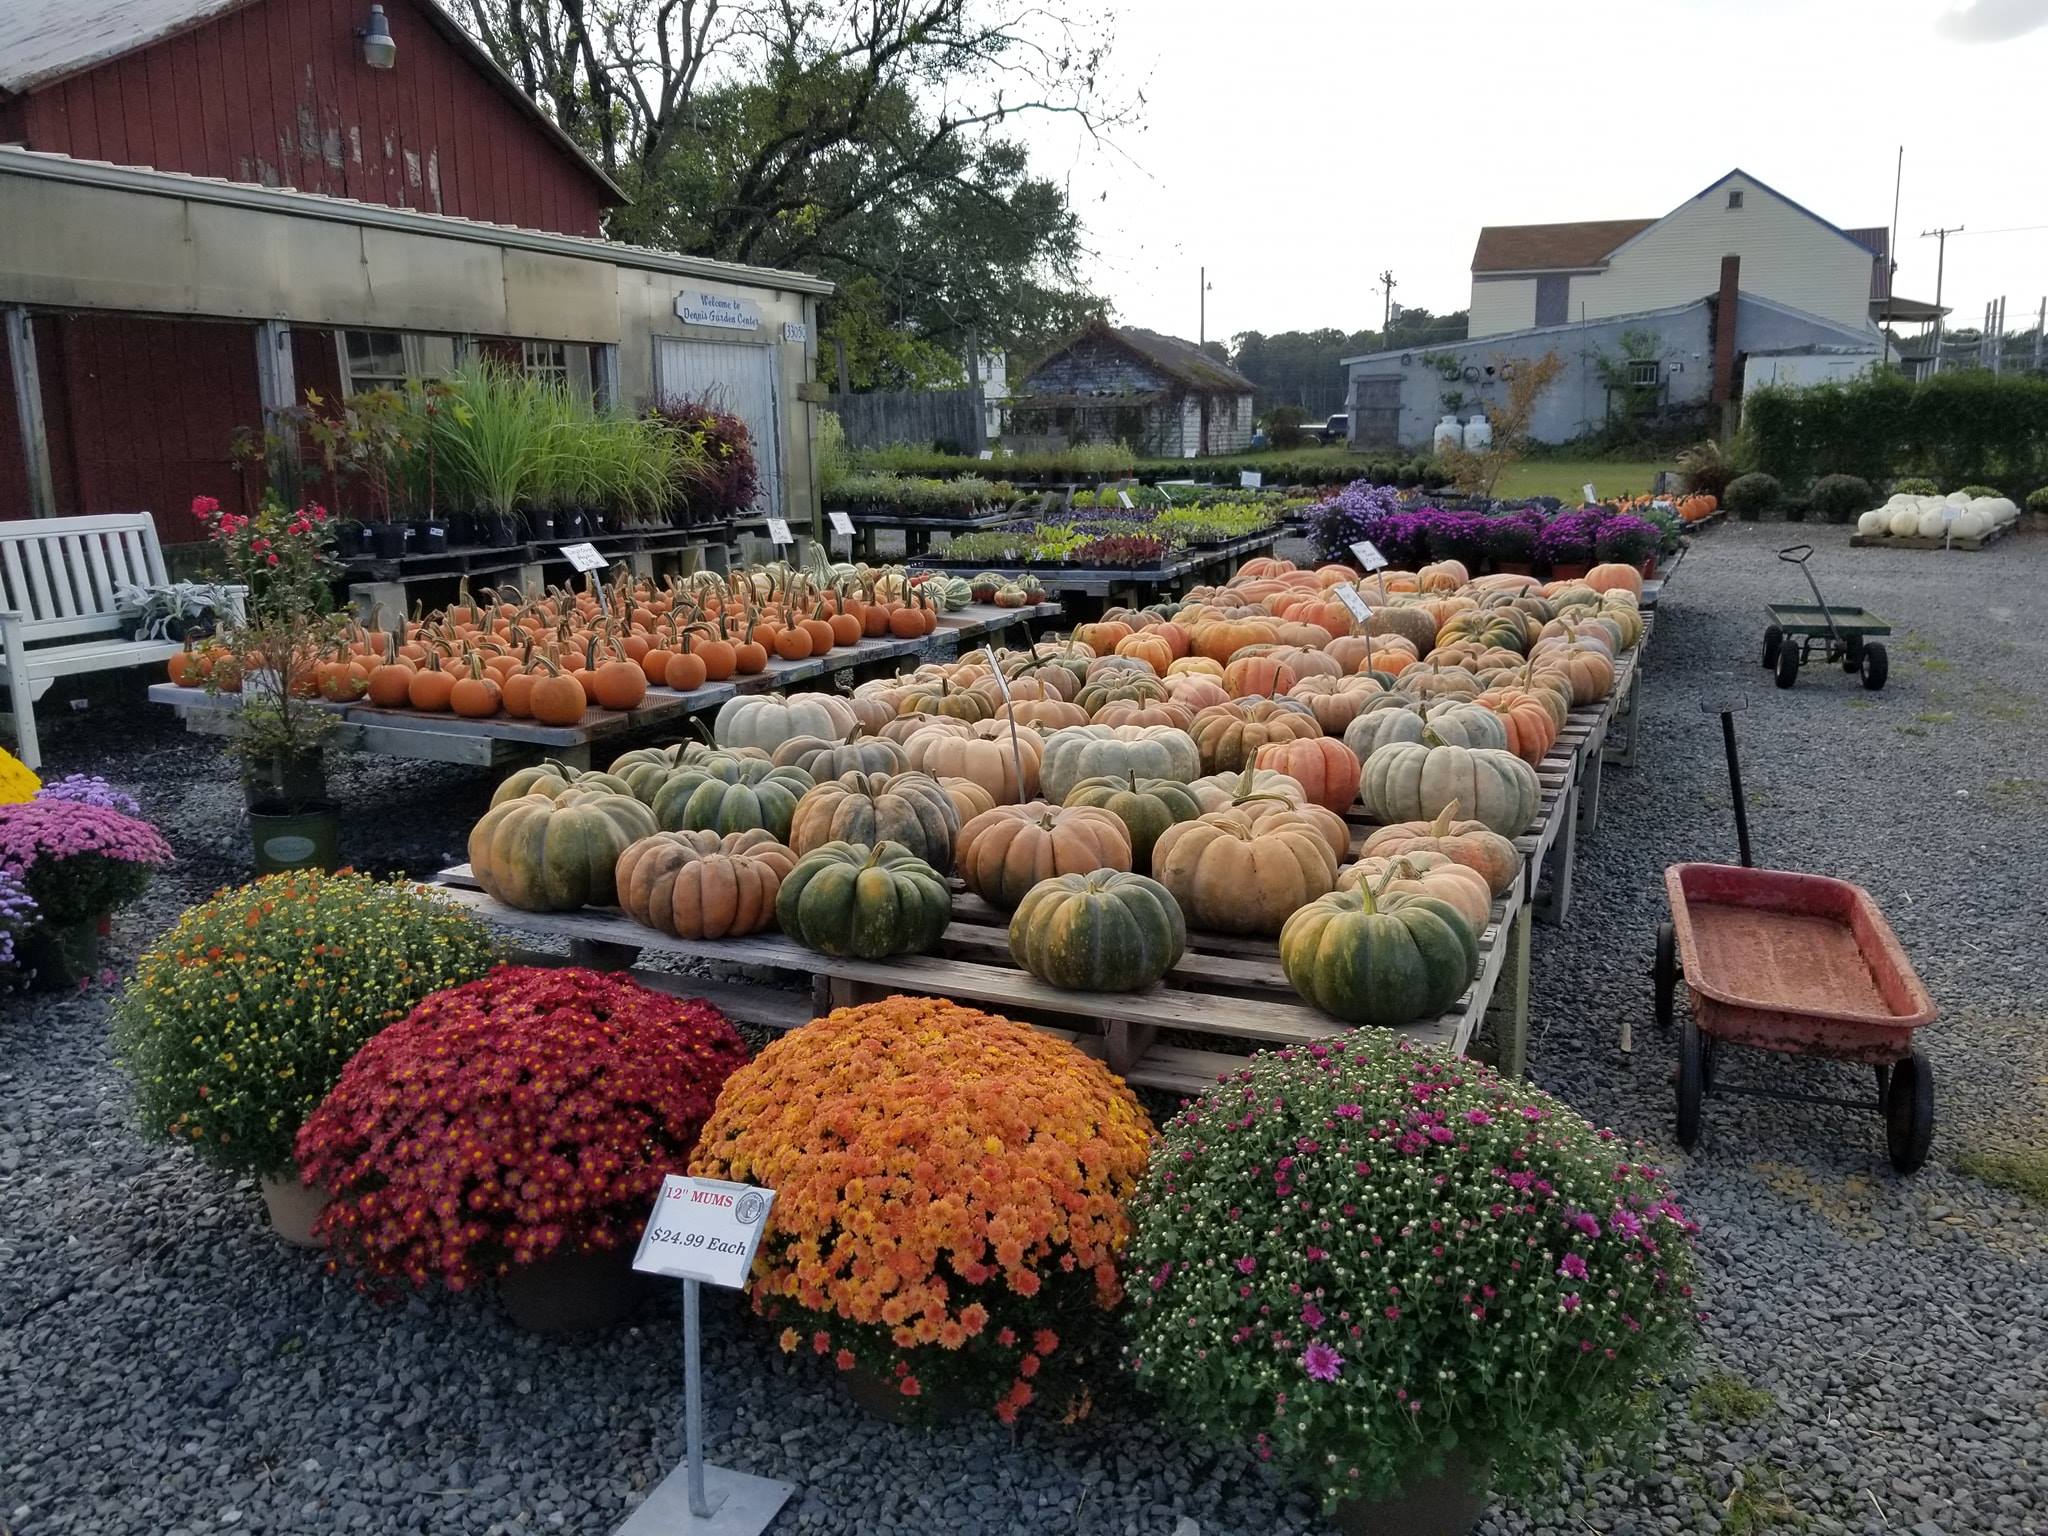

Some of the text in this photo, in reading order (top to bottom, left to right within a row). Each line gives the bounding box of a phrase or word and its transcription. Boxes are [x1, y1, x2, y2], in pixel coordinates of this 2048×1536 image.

[701, 295, 740, 309] Welcome to
[684, 307, 759, 326] Dennis Garden Center
[666, 1187, 733, 1207] 12" MUMS
[651, 1227, 746, 1255] $24.99 Each
